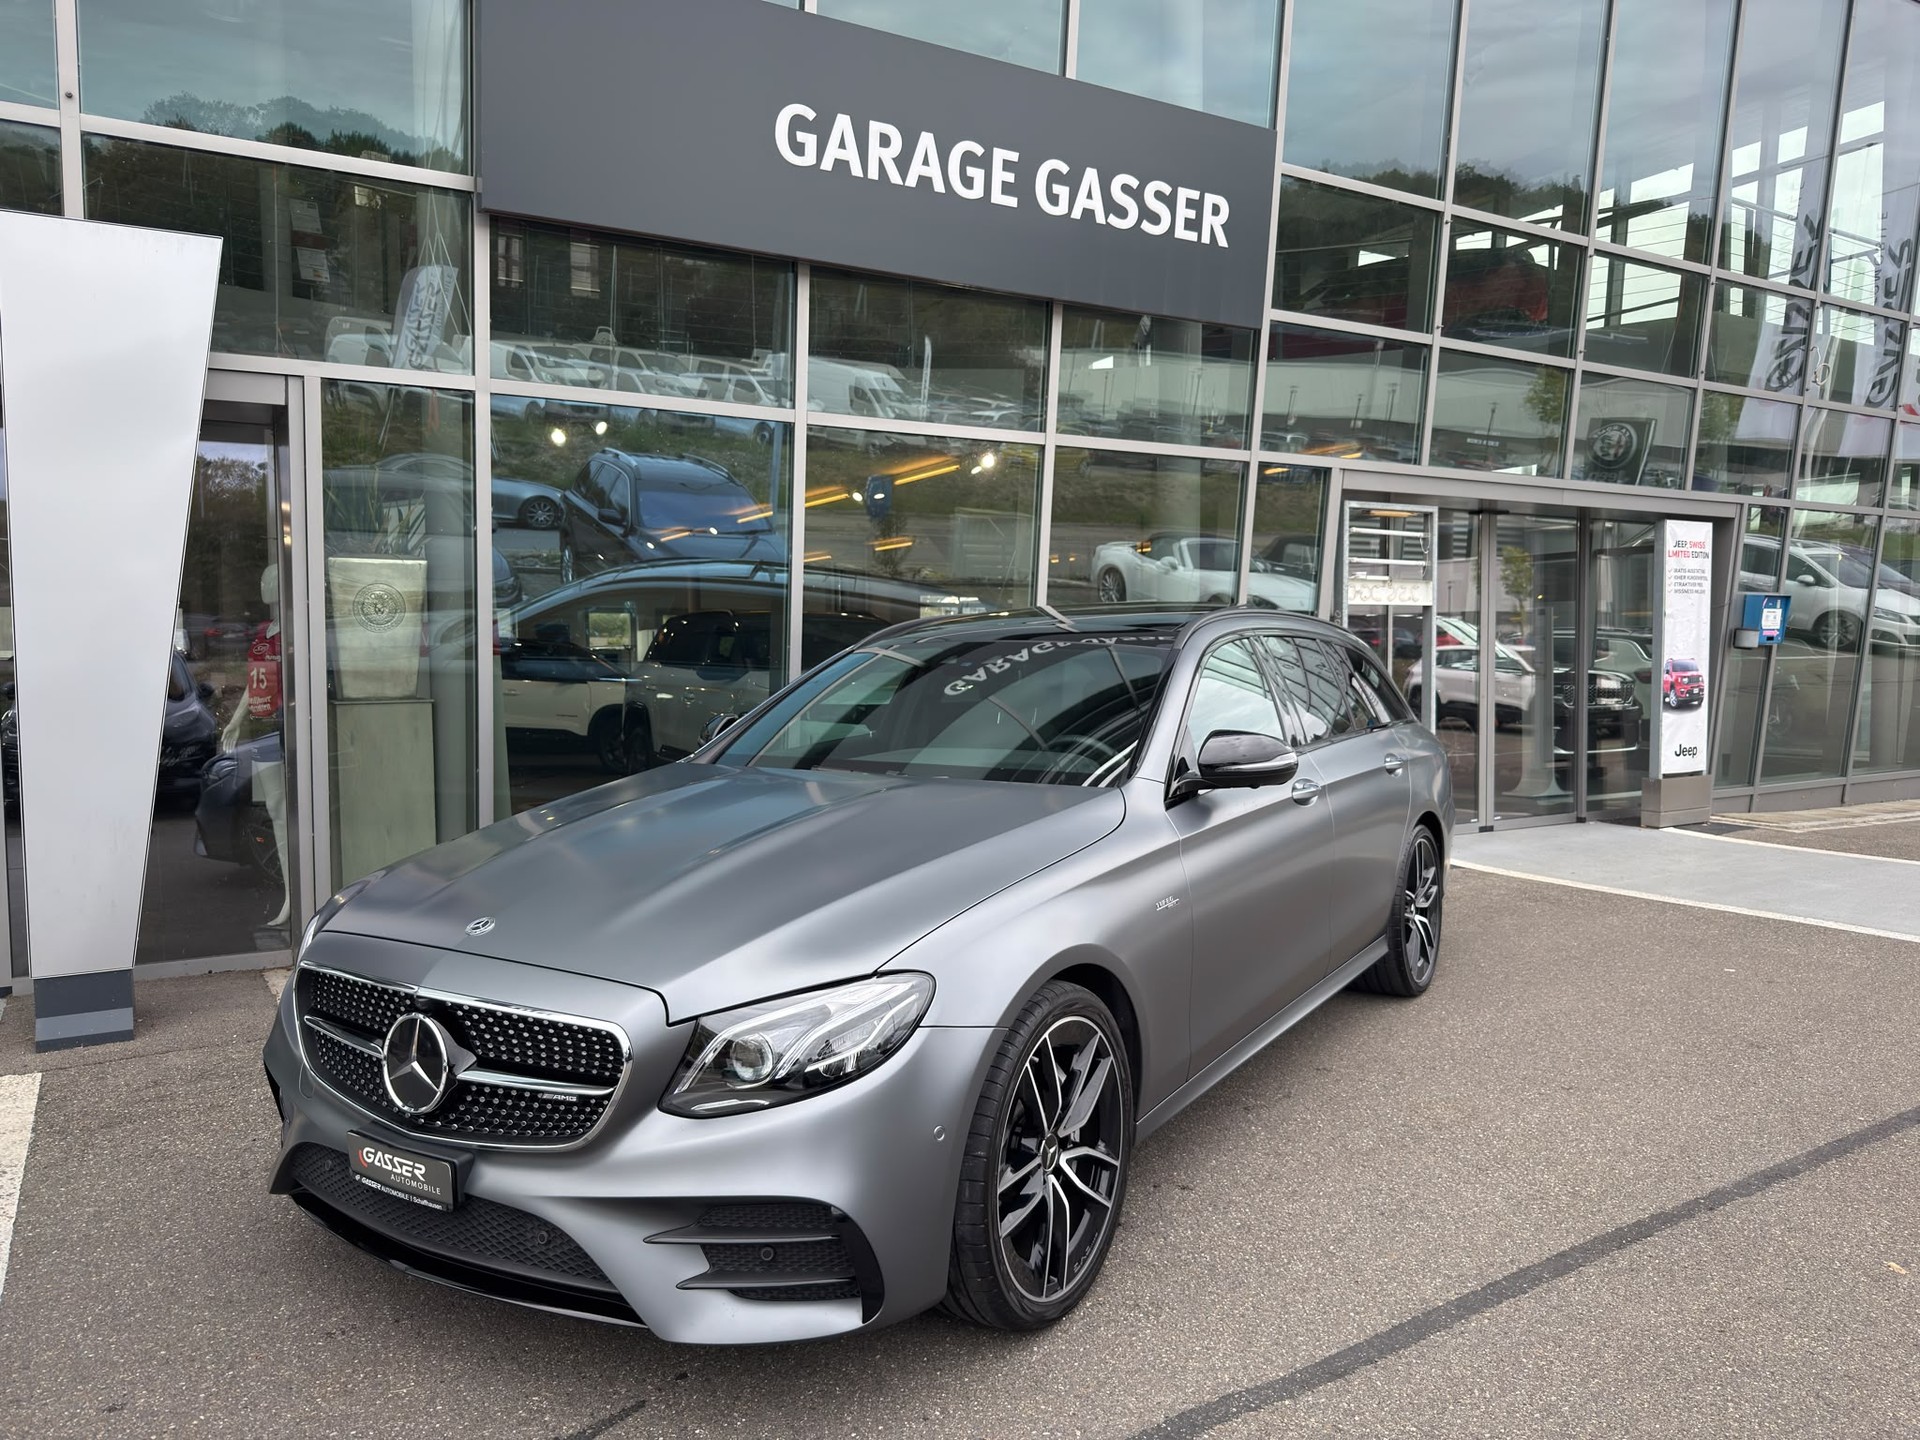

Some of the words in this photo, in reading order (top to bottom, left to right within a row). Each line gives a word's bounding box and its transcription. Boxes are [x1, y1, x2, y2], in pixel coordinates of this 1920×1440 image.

[775, 103, 1019, 208] GARAGE
[1035, 158, 1230, 248] GASSER
[1673, 540, 1687, 548] JEEP
[1689, 541, 1706, 549] SWISS
[250, 667, 268, 689] 15
[1674, 744, 1698, 758] Jeep
[553, 1094, 577, 1102] AMG
[362, 1147, 426, 1182] GASSER
[361, 1177, 382, 1191] GASSER
[381, 1185, 409, 1201] AUTOMOBILE
[413, 1196, 443, 1210] Schaffhausen
[390, 1174, 441, 1195] AUTOMOBILE
